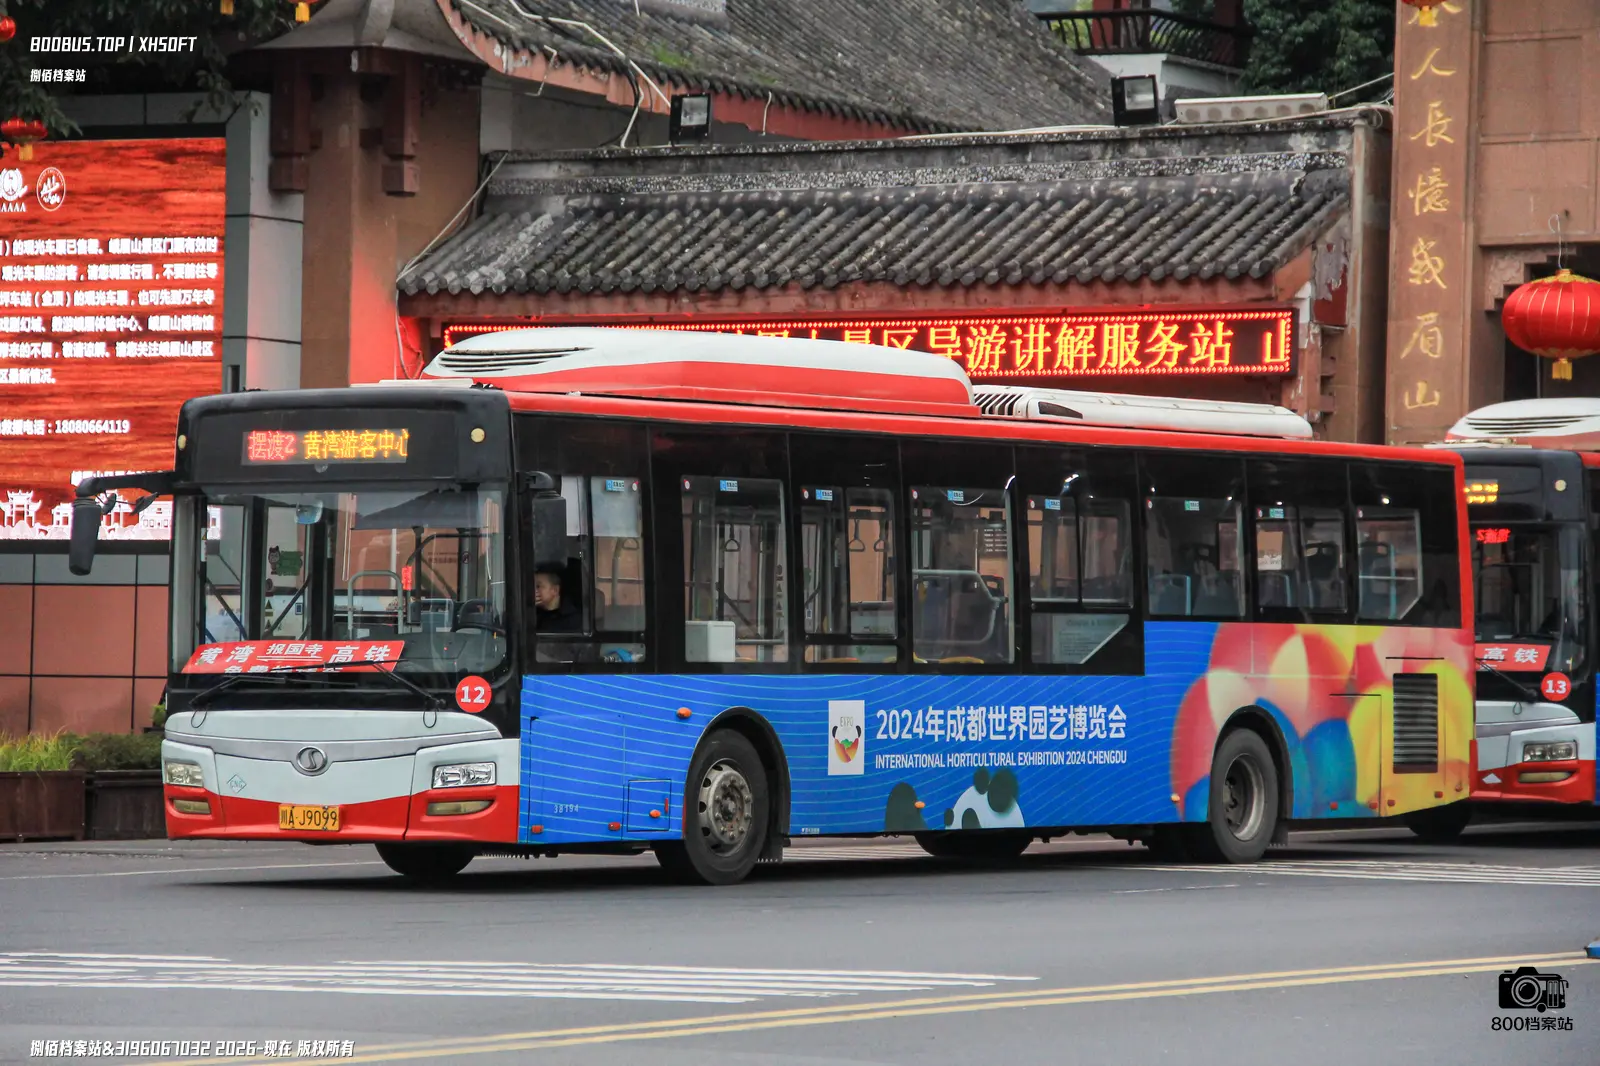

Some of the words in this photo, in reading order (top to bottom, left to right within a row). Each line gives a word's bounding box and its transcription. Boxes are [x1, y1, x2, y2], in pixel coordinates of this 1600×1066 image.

[248, 430, 296, 461] 摆渡2
[196, 646, 255, 665] 黄湾
[265, 643, 324, 657] 报国寺
[328, 645, 393, 664] 高铁
[1483, 647, 1539, 664] 高铁
[460, 685, 486, 704] 12
[1545, 680, 1567, 694] 13
[876, 704, 1127, 742] 2024年成都世界园艺博览会
[875, 754, 945, 769] INTERNATIONAL
[947, 751, 1016, 768] HORTICULTURAL
[1018, 751, 1064, 766] EXHIBITION
[1066, 751, 1086, 765] 2024
[1087, 750, 1127, 764] CHENGDU
